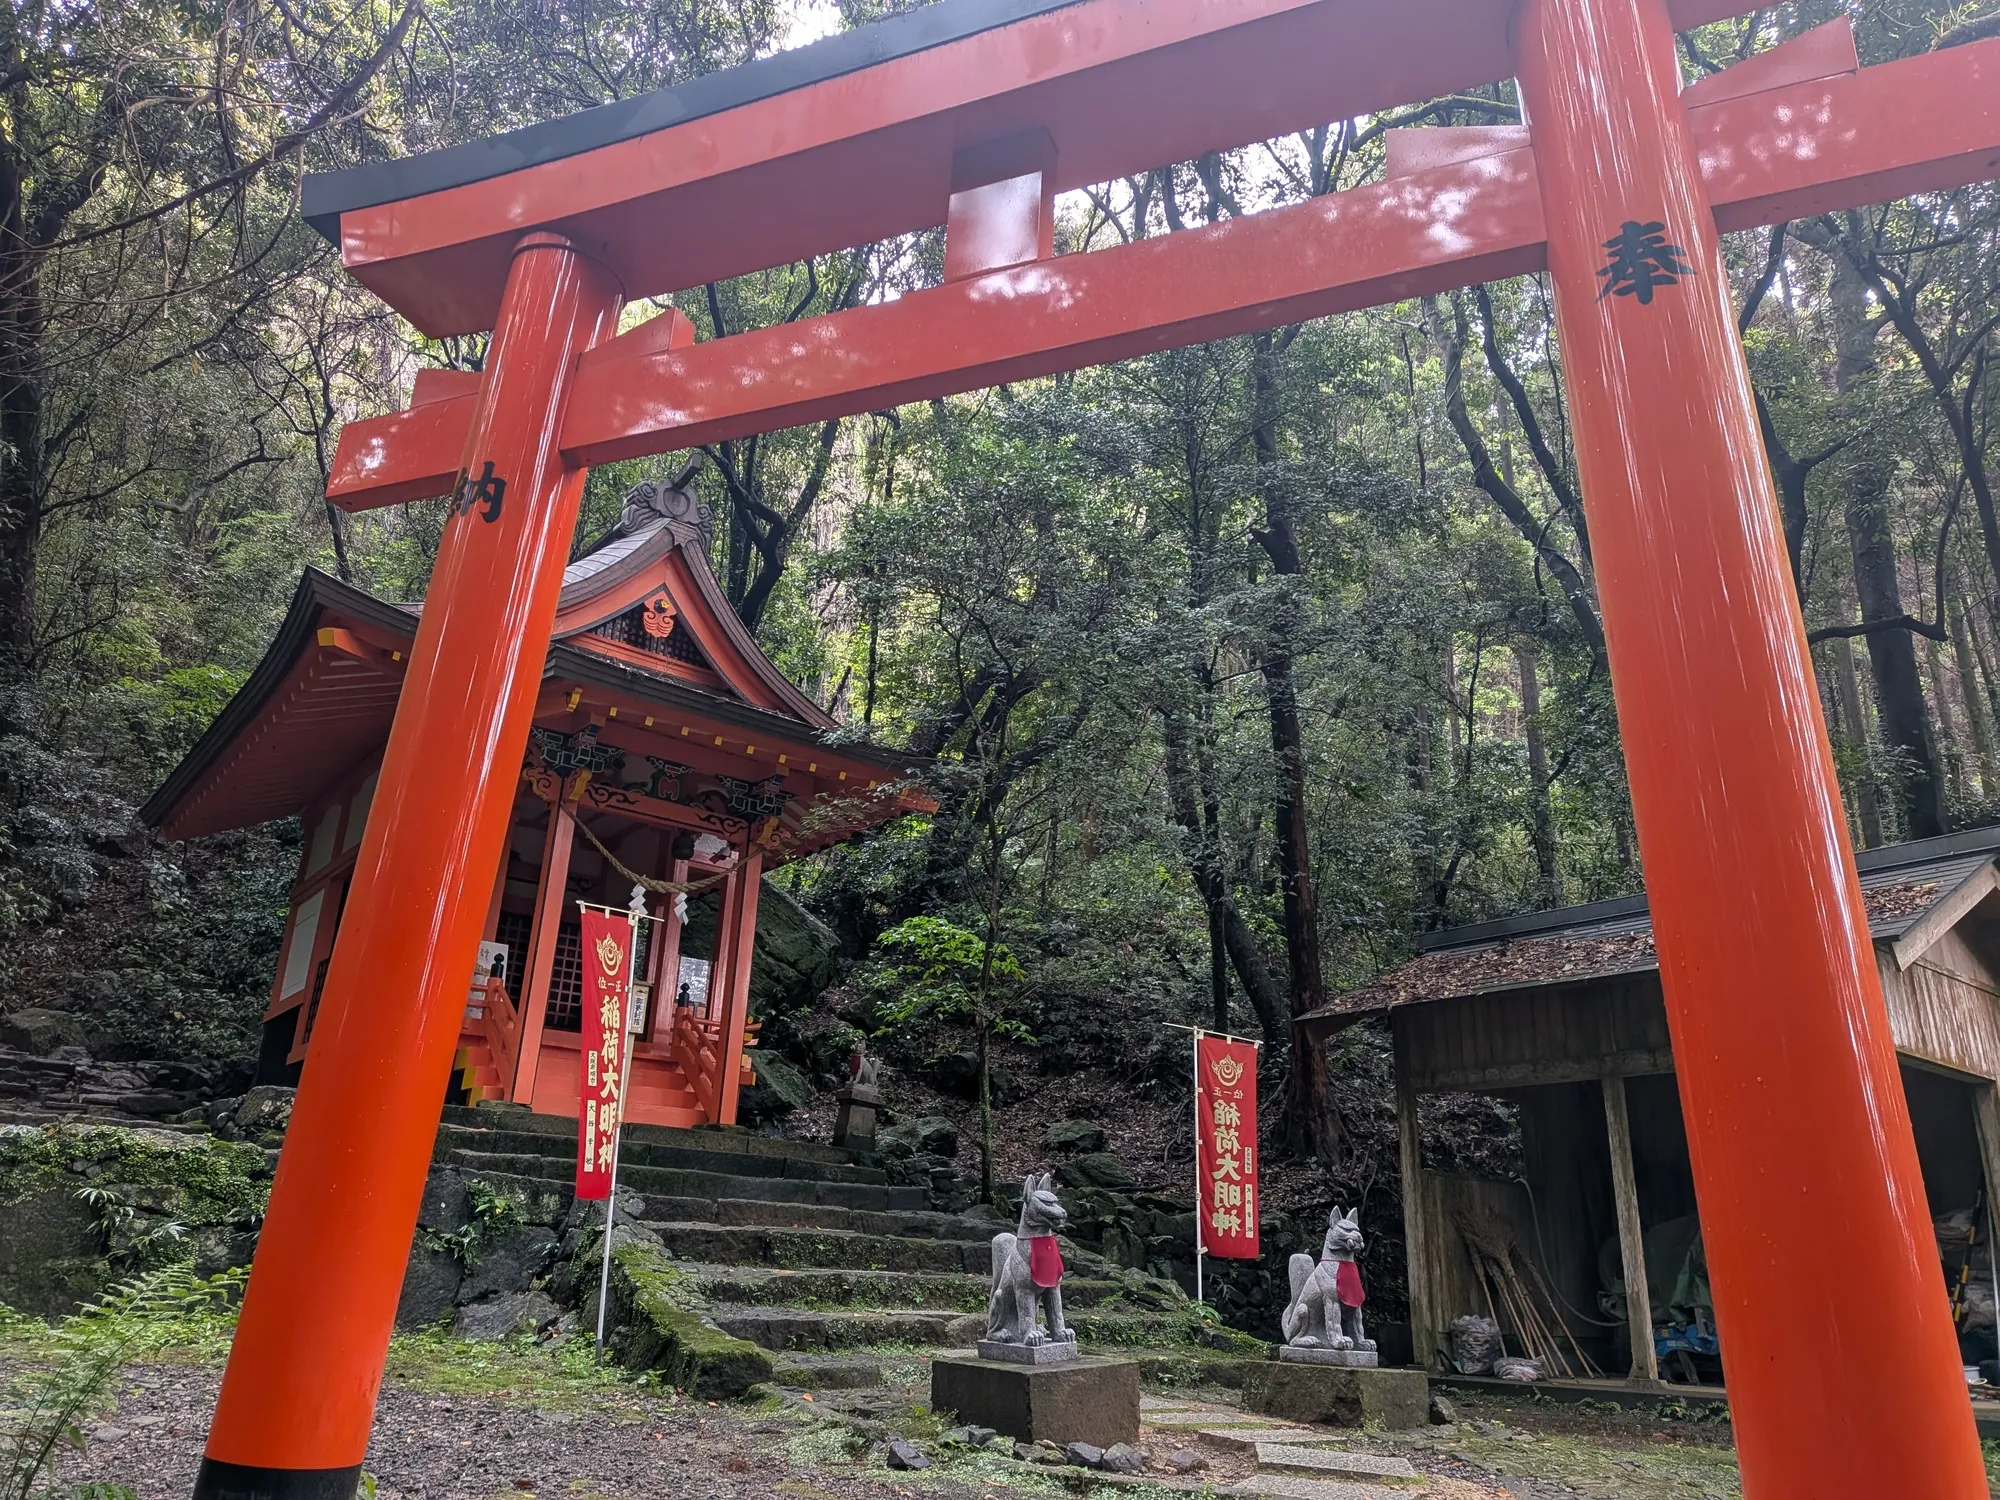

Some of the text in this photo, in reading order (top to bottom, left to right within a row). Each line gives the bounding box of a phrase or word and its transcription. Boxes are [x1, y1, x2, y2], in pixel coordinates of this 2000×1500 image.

[1595, 220, 1697, 305] 奉
[449, 460, 507, 523] 納
[598, 995, 621, 1174] 稲荷大明神
